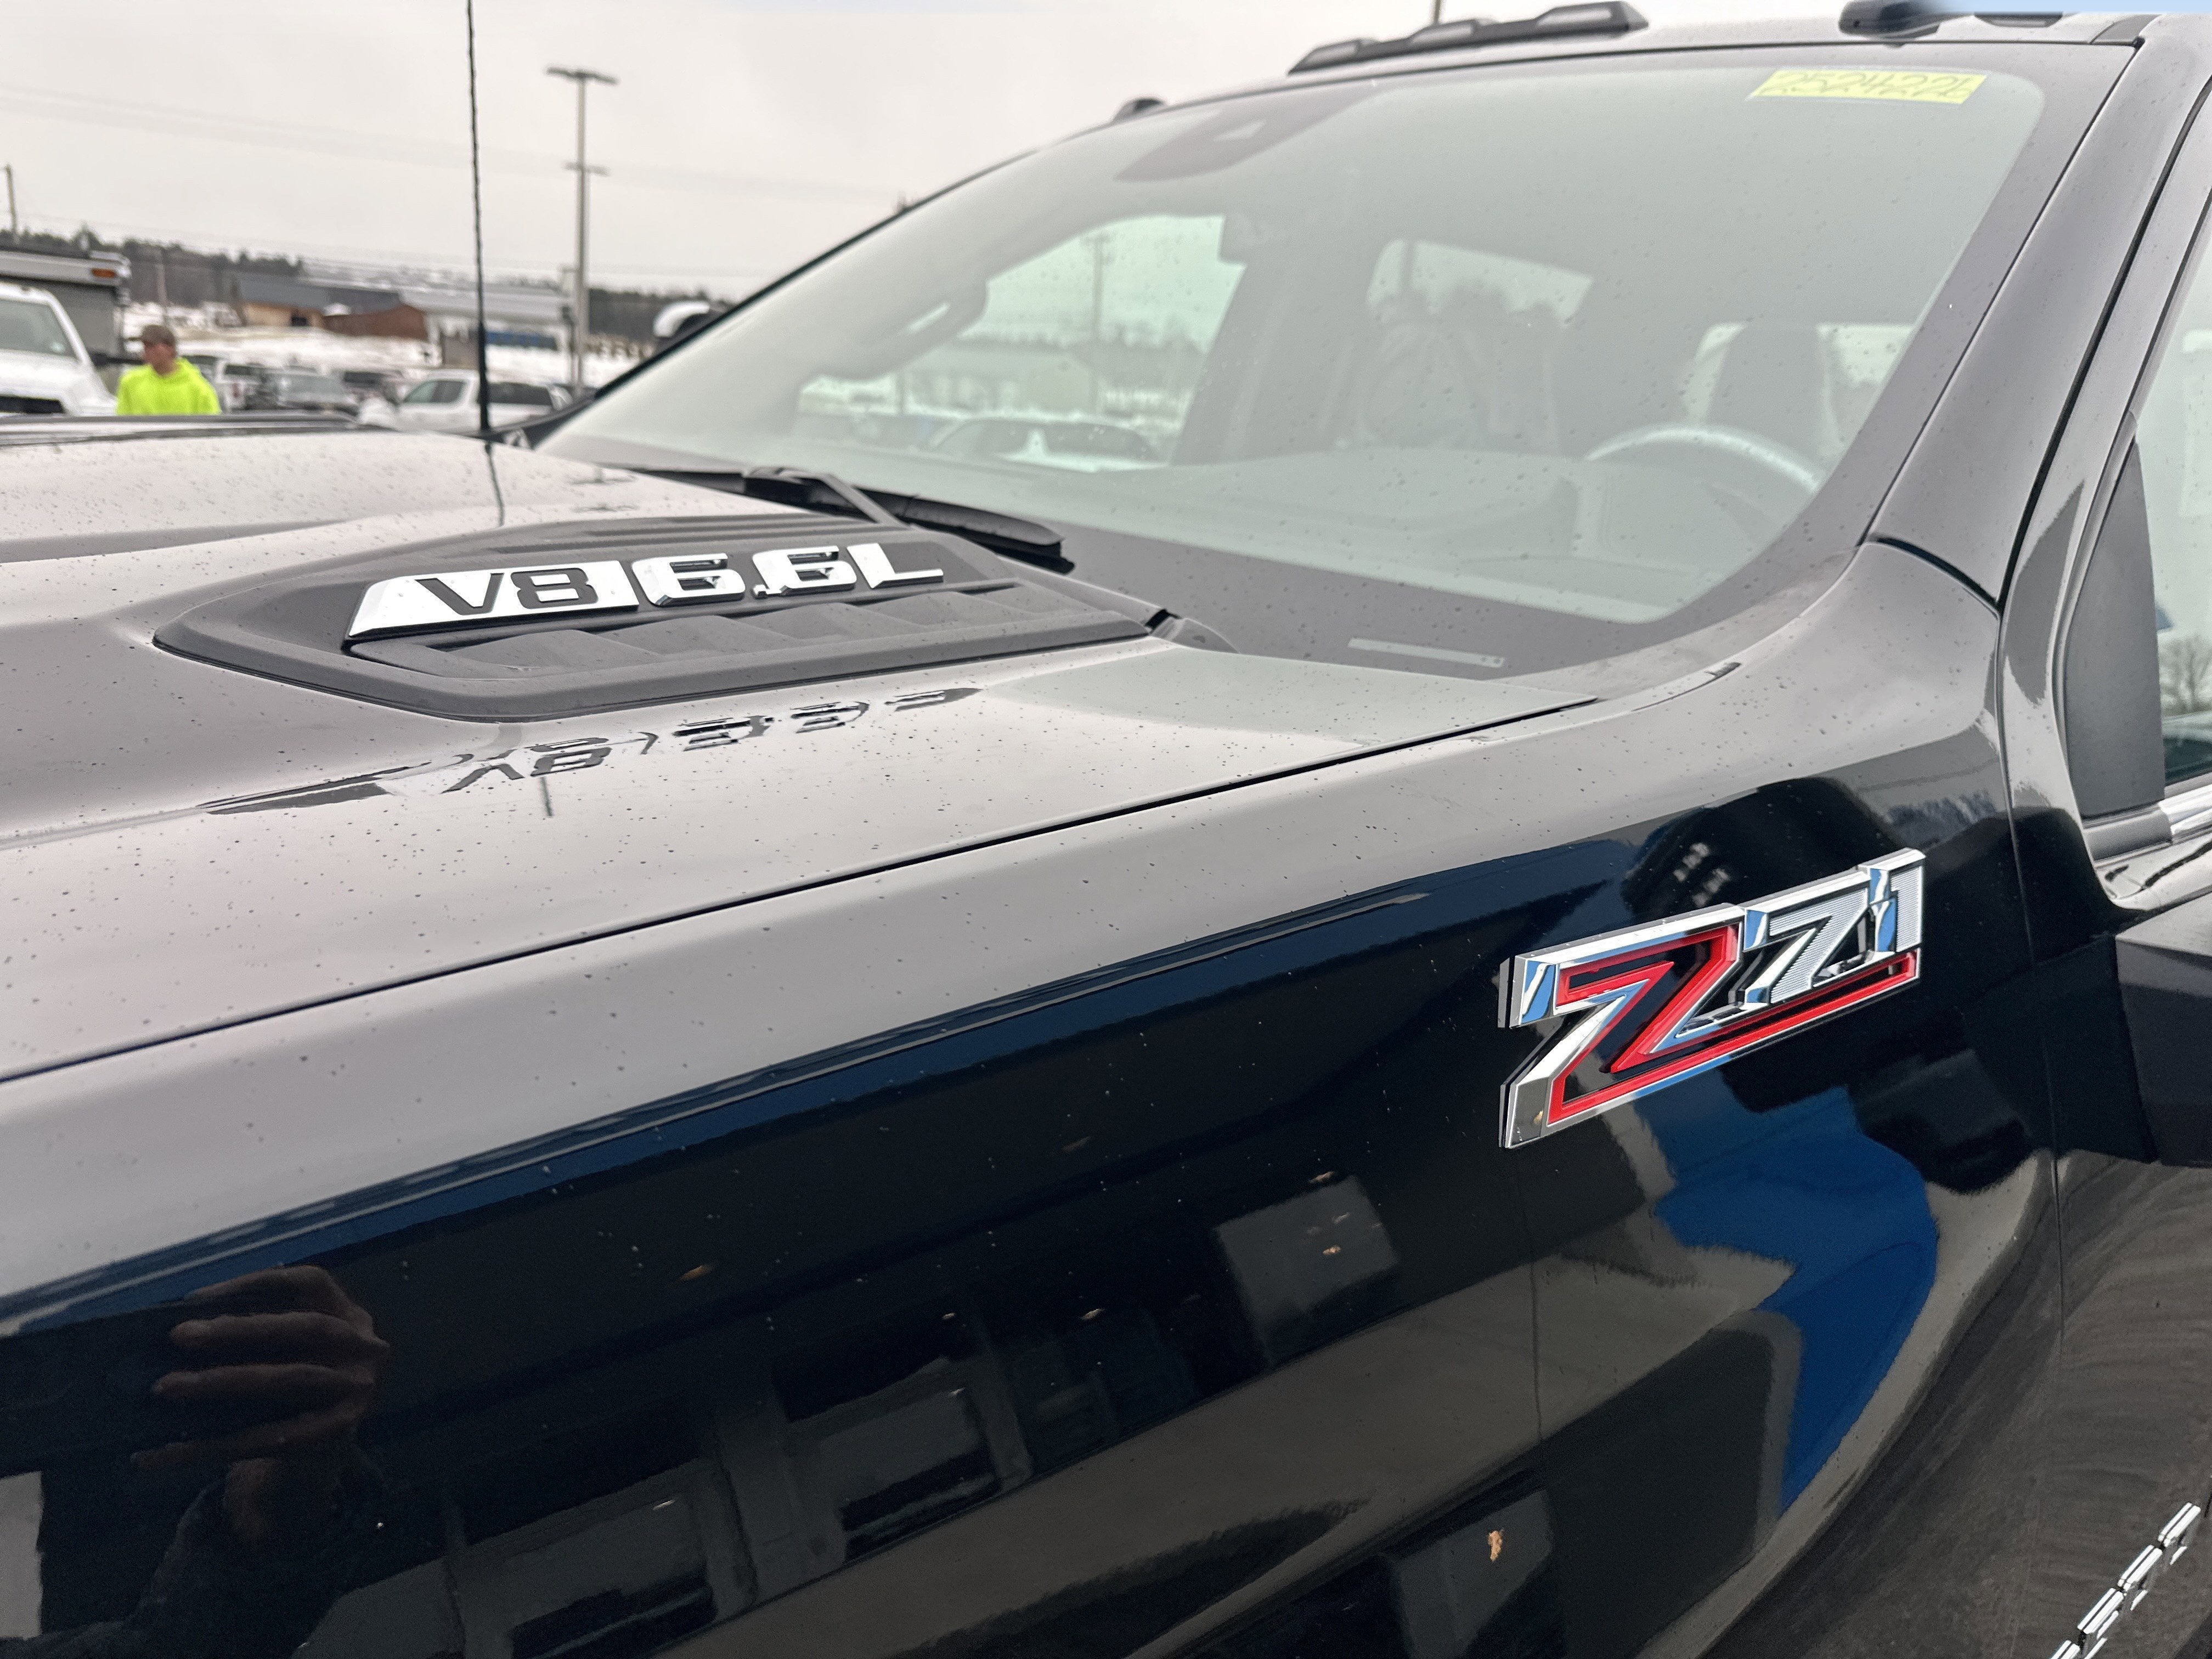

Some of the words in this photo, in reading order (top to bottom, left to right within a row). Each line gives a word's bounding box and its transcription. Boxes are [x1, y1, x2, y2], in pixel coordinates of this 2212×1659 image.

[415, 568, 599, 616] V8
[631, 543, 944, 607] 6.6L
[1500, 848, 1926, 1149] Z71
